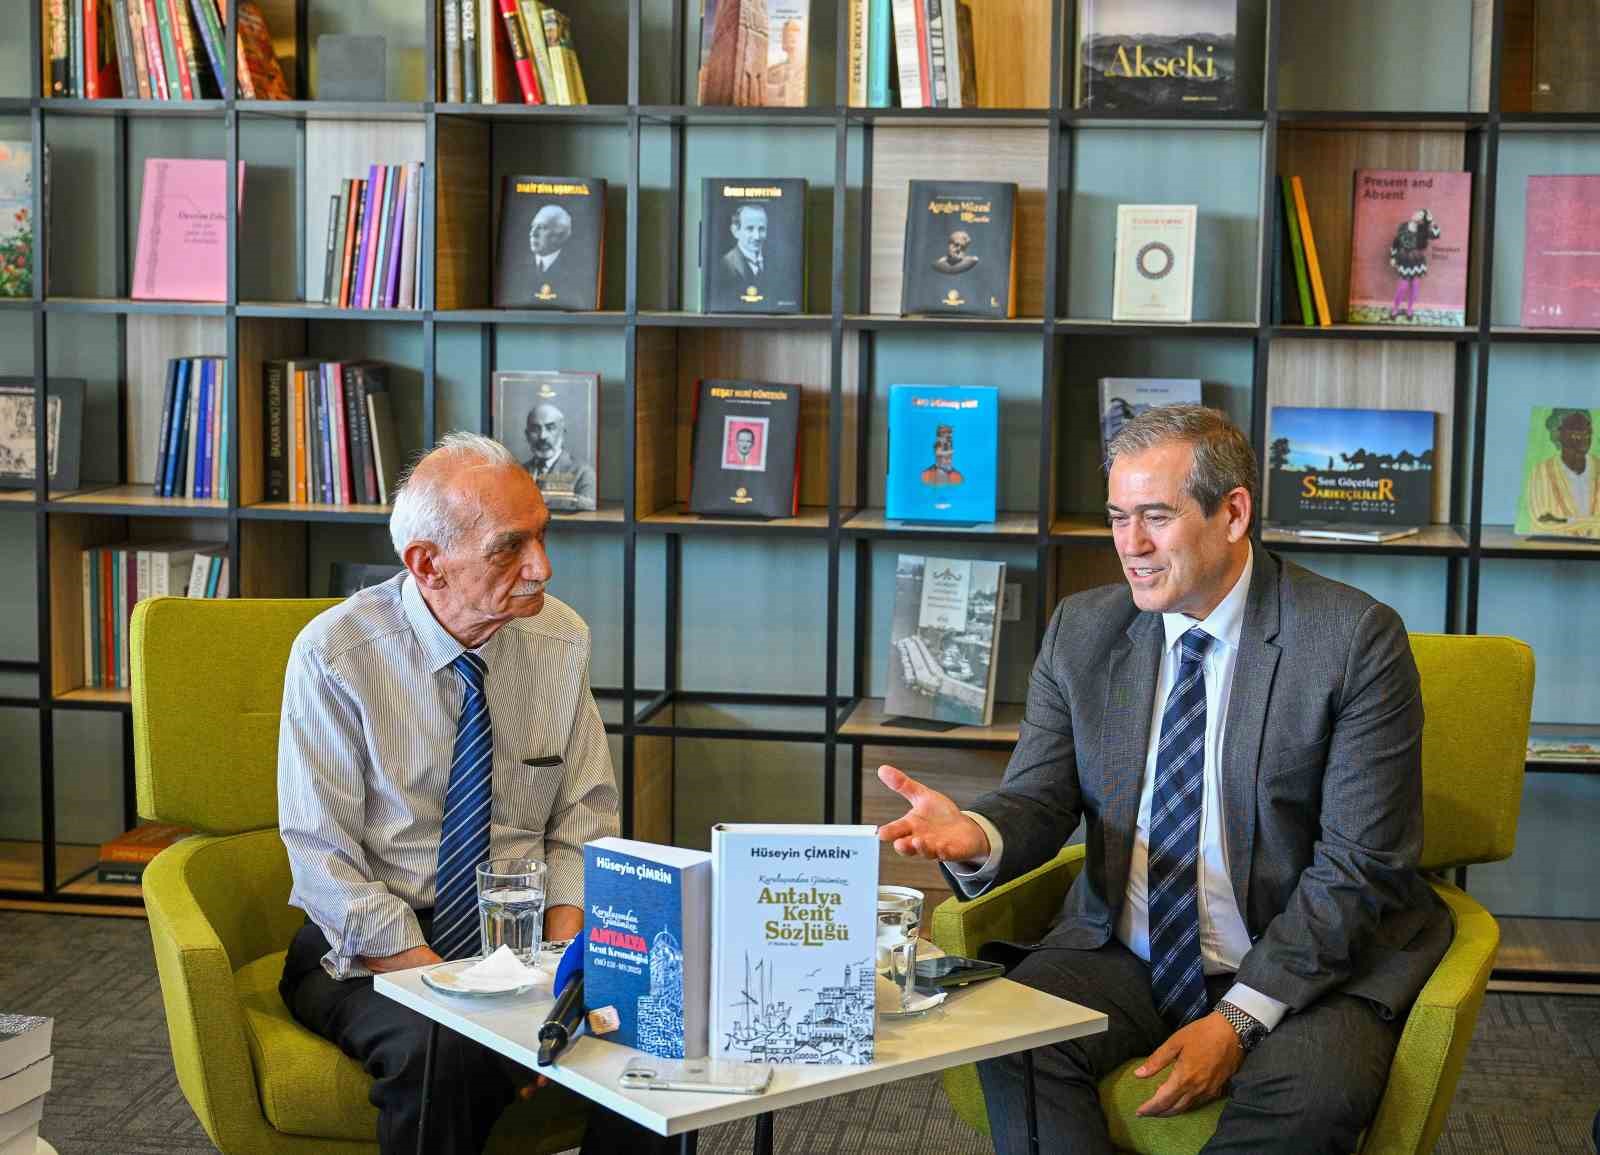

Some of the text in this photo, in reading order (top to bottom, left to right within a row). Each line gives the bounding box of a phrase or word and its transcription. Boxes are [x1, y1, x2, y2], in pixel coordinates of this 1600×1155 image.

[1104, 44, 1215, 78] Akseki
[1363, 176, 1433, 188] Present and
[1363, 190, 1405, 200] Absent
[751, 846, 850, 861] Hüseyin ÇİMRİN
[596, 856, 672, 885] Hüseyin ÇİMRİN
[757, 887, 842, 909] Antalya
[783, 905, 835, 921] Kent
